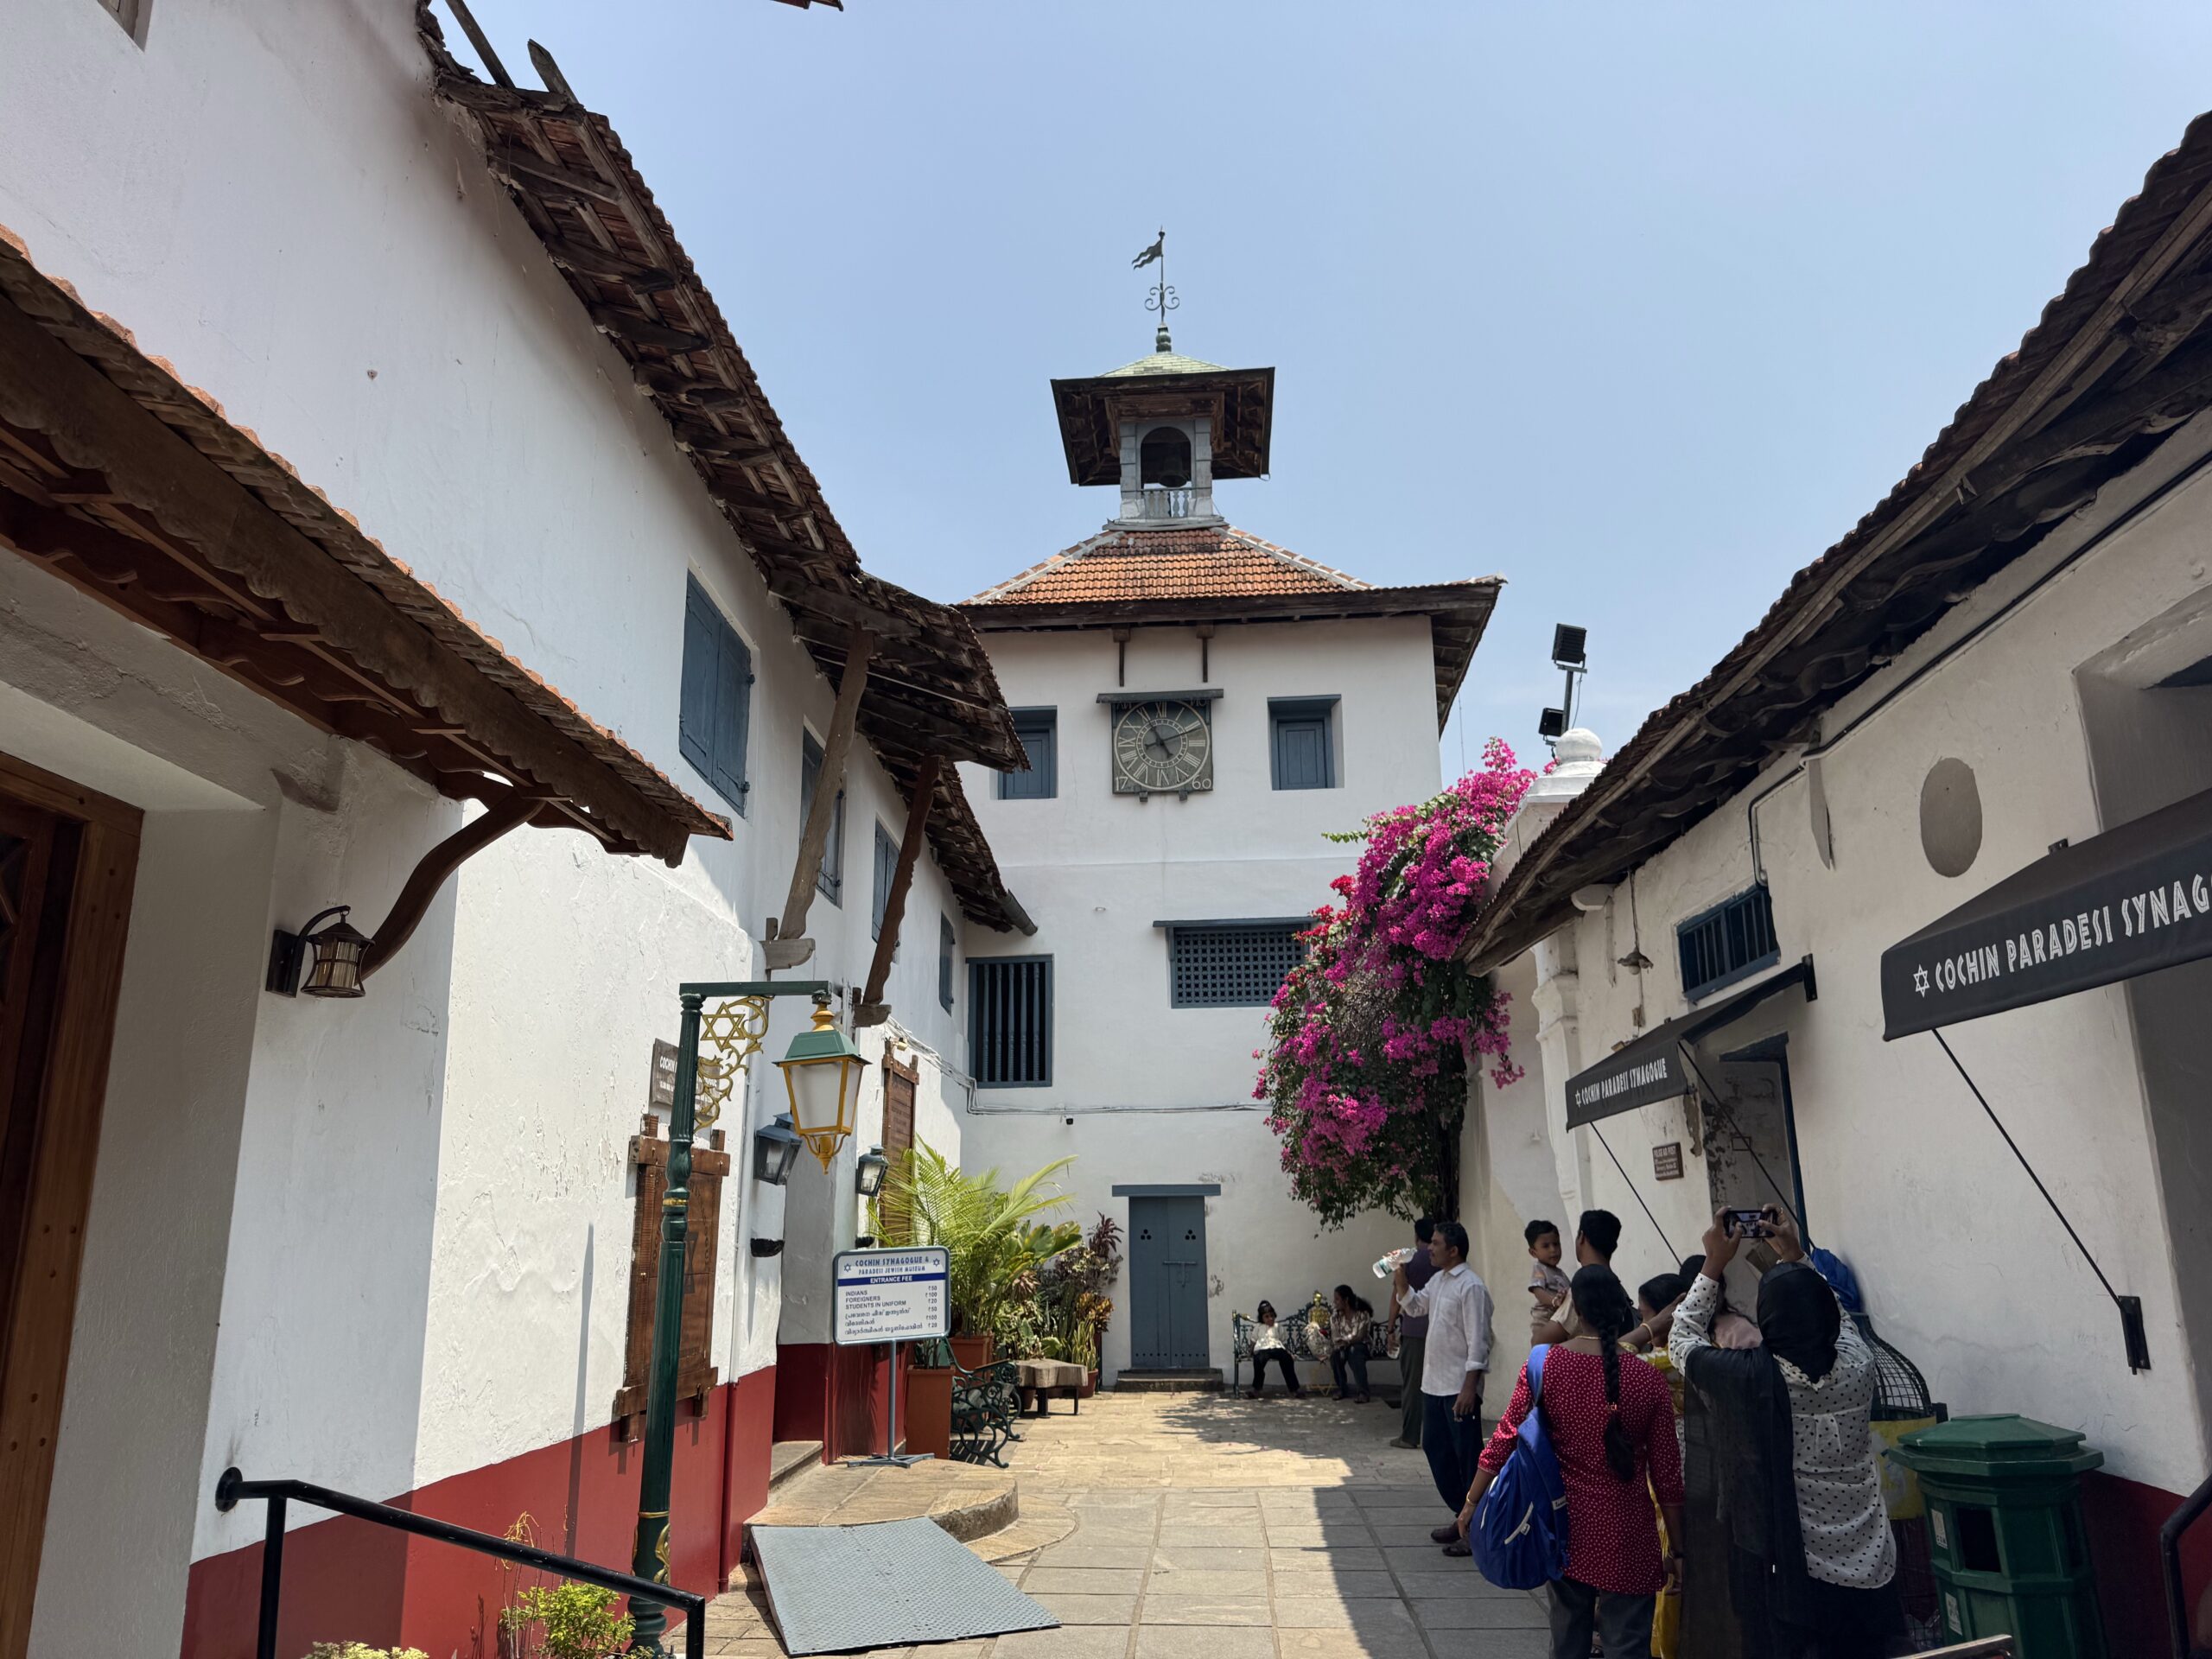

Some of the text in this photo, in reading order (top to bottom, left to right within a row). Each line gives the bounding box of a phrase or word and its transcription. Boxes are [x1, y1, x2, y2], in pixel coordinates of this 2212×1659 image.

[1115, 774, 1211, 791] 17 60
[1935, 874, 2212, 993] COCHIN PARADESI SYNAG
[1581, 1058, 1668, 1105] COCHIN PARADESI SYNAGOGUE
[883, 1256, 923, 1266] SYNAGOGUE
